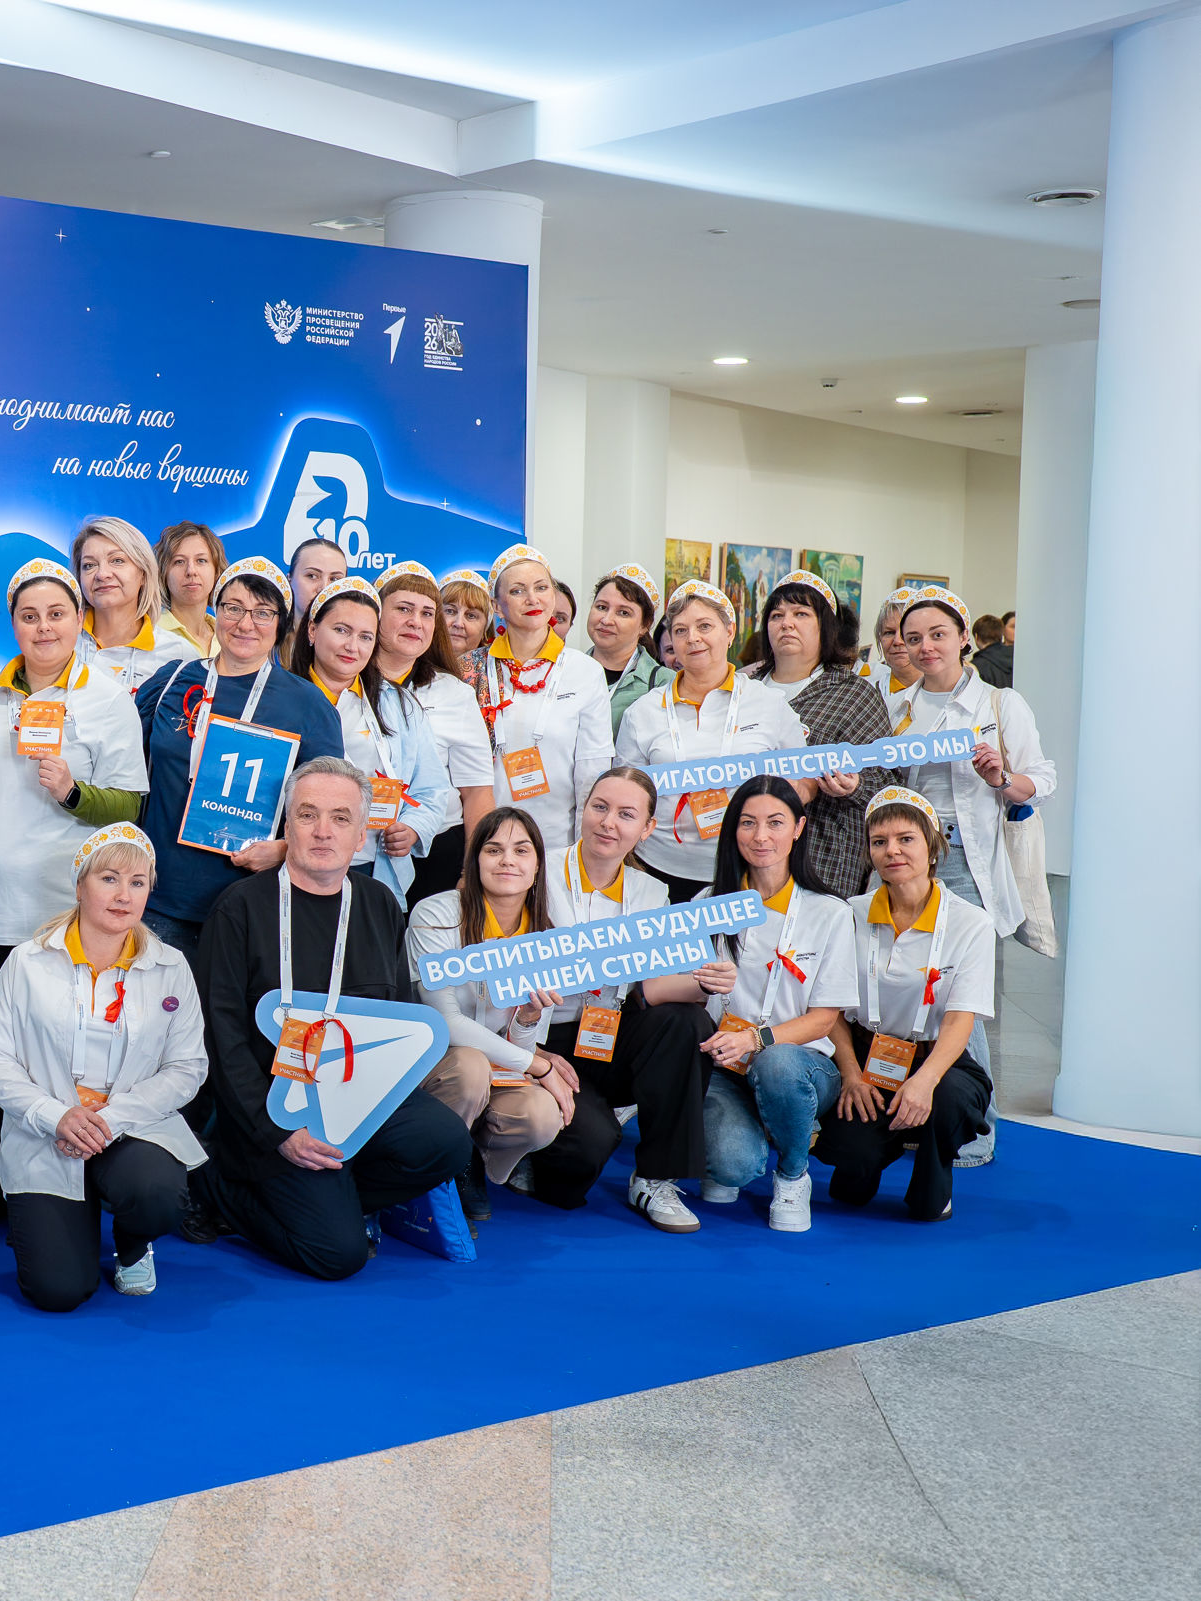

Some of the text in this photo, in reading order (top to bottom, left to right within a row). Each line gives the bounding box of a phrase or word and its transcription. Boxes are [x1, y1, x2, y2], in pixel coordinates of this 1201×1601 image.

[305, 306, 364, 321] МИНИСТЕРСТВО
[382, 303, 407, 314] Первые
[305, 316, 360, 330] ПРОСВЕЩЕНИЯ
[305, 325, 354, 338] РОССИЙСКОЙ
[424, 322, 439, 337] 20
[305, 334, 350, 347] ФЕДЕРАЦИИ
[423, 336, 438, 350] 26
[136, 405, 176, 429] нас
[51, 440, 250, 493] на новые вершины
[358, 552, 396, 569] лет
[652, 760, 757, 790] ИГАТОРЫ
[763, 750, 856, 777] ДЕТСТВА
[884, 742, 927, 763] ЭТО
[932, 735, 972, 757] МЫ
[220, 752, 264, 803] 11
[201, 799, 263, 823] команда
[425, 897, 760, 984] ВОСПИТЫВАЕМ БУДУЩЕЕ
[494, 939, 709, 1001] НАШЕЙ СТРАНЫ
